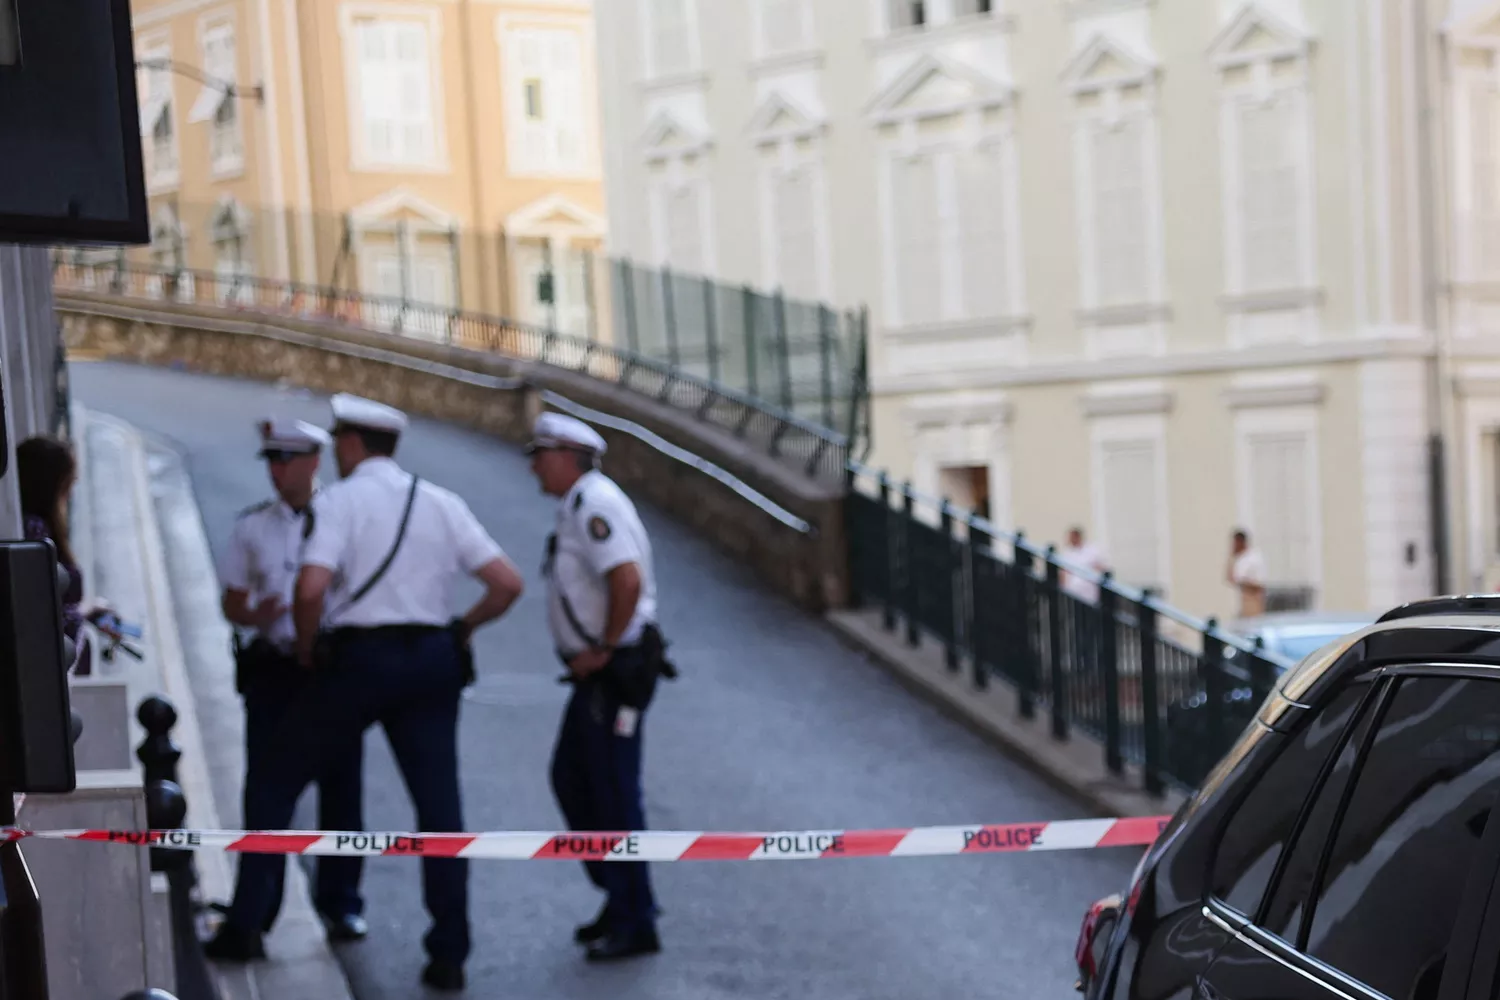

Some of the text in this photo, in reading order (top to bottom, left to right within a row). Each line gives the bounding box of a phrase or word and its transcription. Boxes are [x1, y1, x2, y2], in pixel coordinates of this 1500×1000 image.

[335, 834, 425, 852] POLICE
[553, 835, 639, 854] POLICE
[762, 835, 845, 853] POLICE
[963, 828, 1043, 848] POLICE
